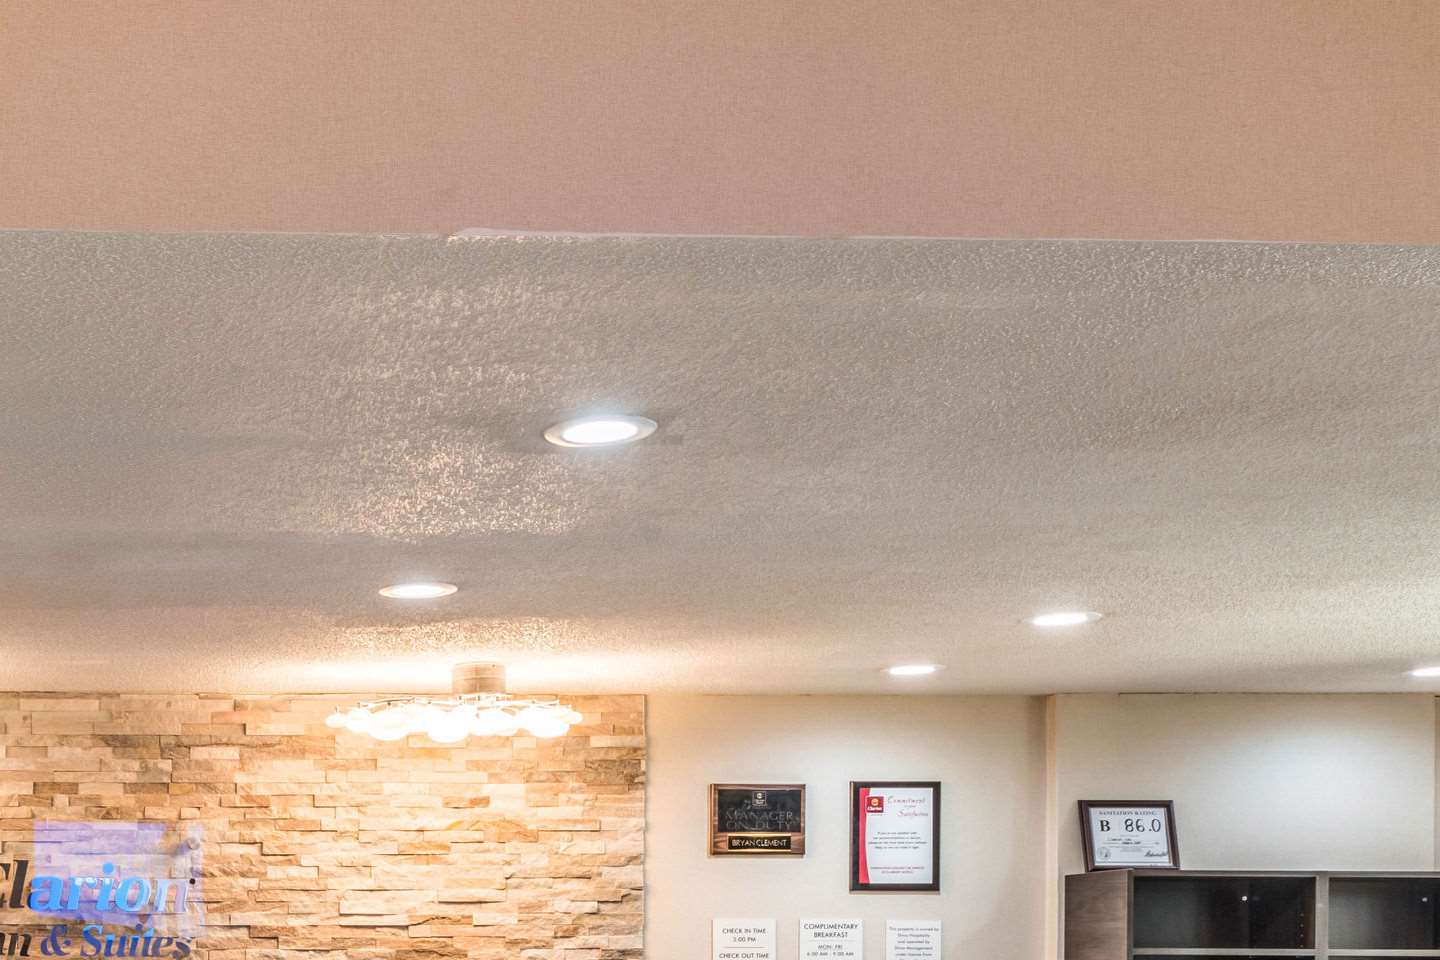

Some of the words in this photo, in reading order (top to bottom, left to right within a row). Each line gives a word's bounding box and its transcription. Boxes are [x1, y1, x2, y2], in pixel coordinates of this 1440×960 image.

[1099, 819, 1111, 832] B
[731, 839, 755, 847] BRYAN
[755, 839, 787, 847] CLEMENT
[40, 924, 72, 957] &
[80, 923, 192, 960] Suites
